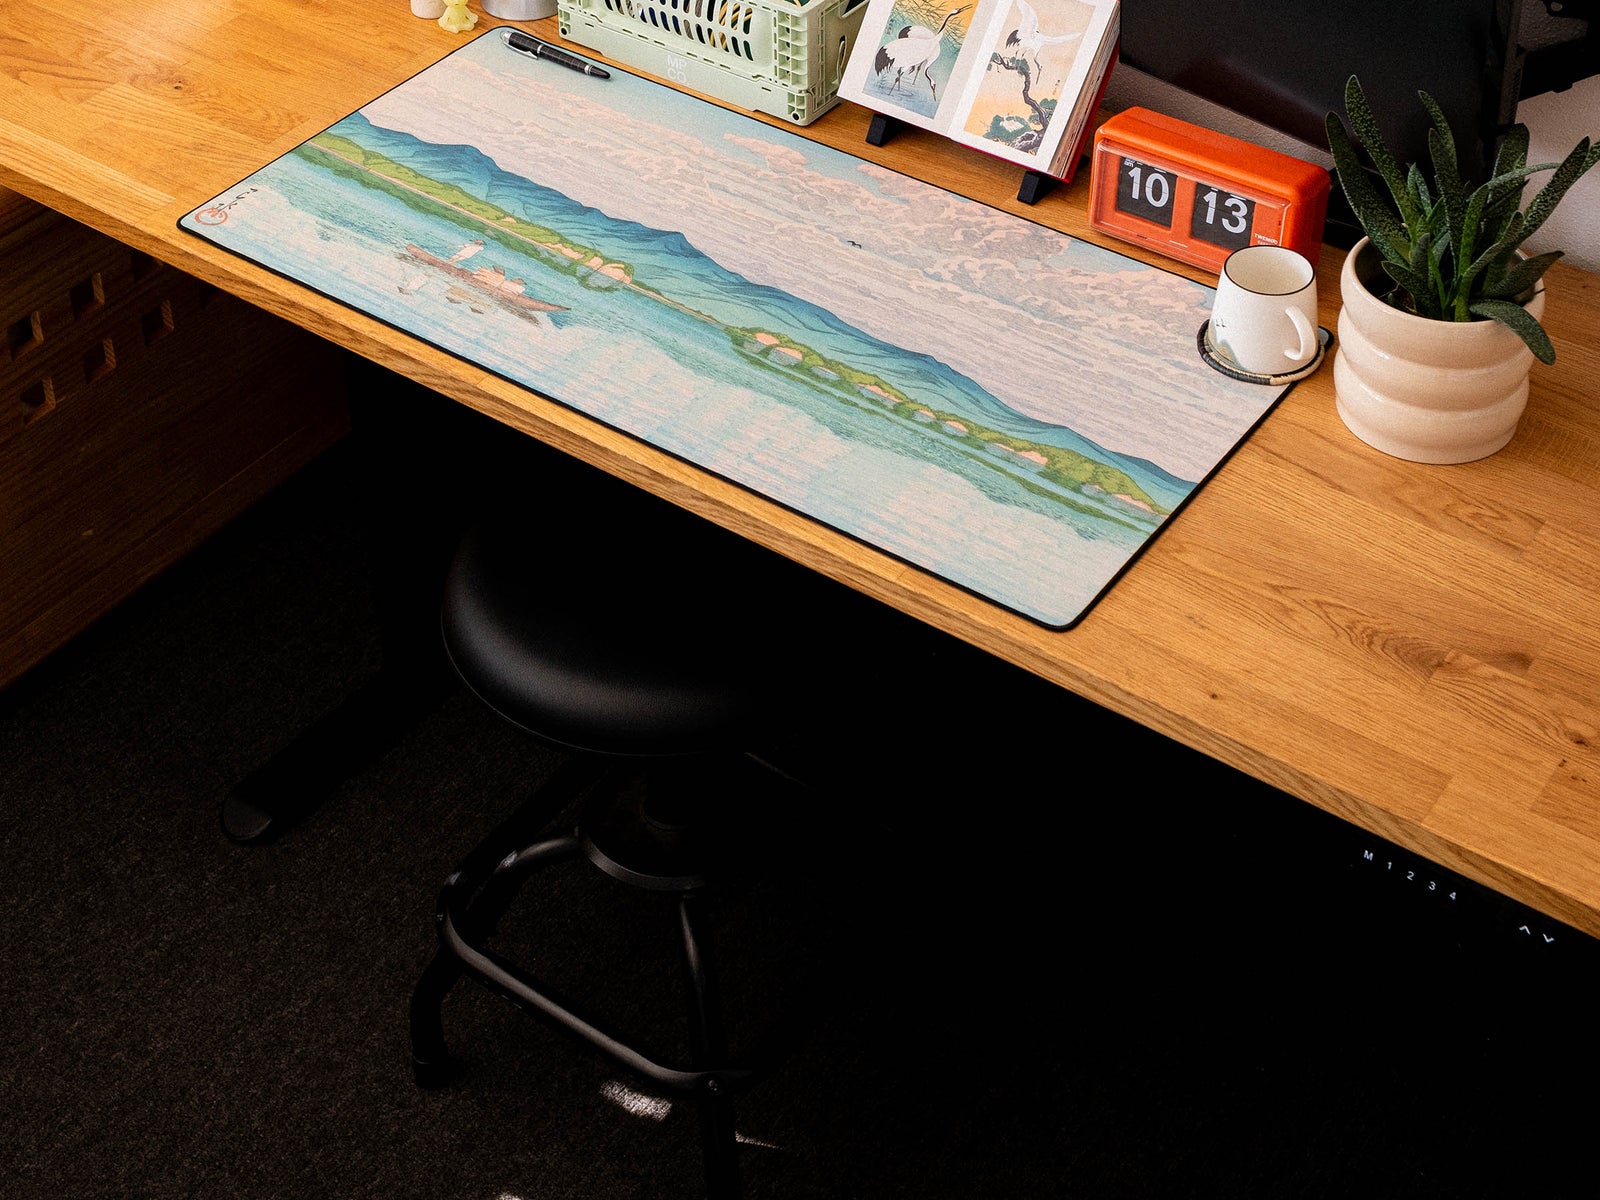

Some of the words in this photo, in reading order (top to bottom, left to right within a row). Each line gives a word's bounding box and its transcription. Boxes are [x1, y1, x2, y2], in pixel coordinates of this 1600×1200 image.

[1128, 166, 1170, 208] 10
[1203, 191, 1248, 234] 13
[1363, 850, 1373, 861] M
[1387, 861, 1392, 870] 1
[1406, 871, 1414, 880] 2
[1428, 881, 1436, 890] 3
[1449, 892, 1456, 900] 4
